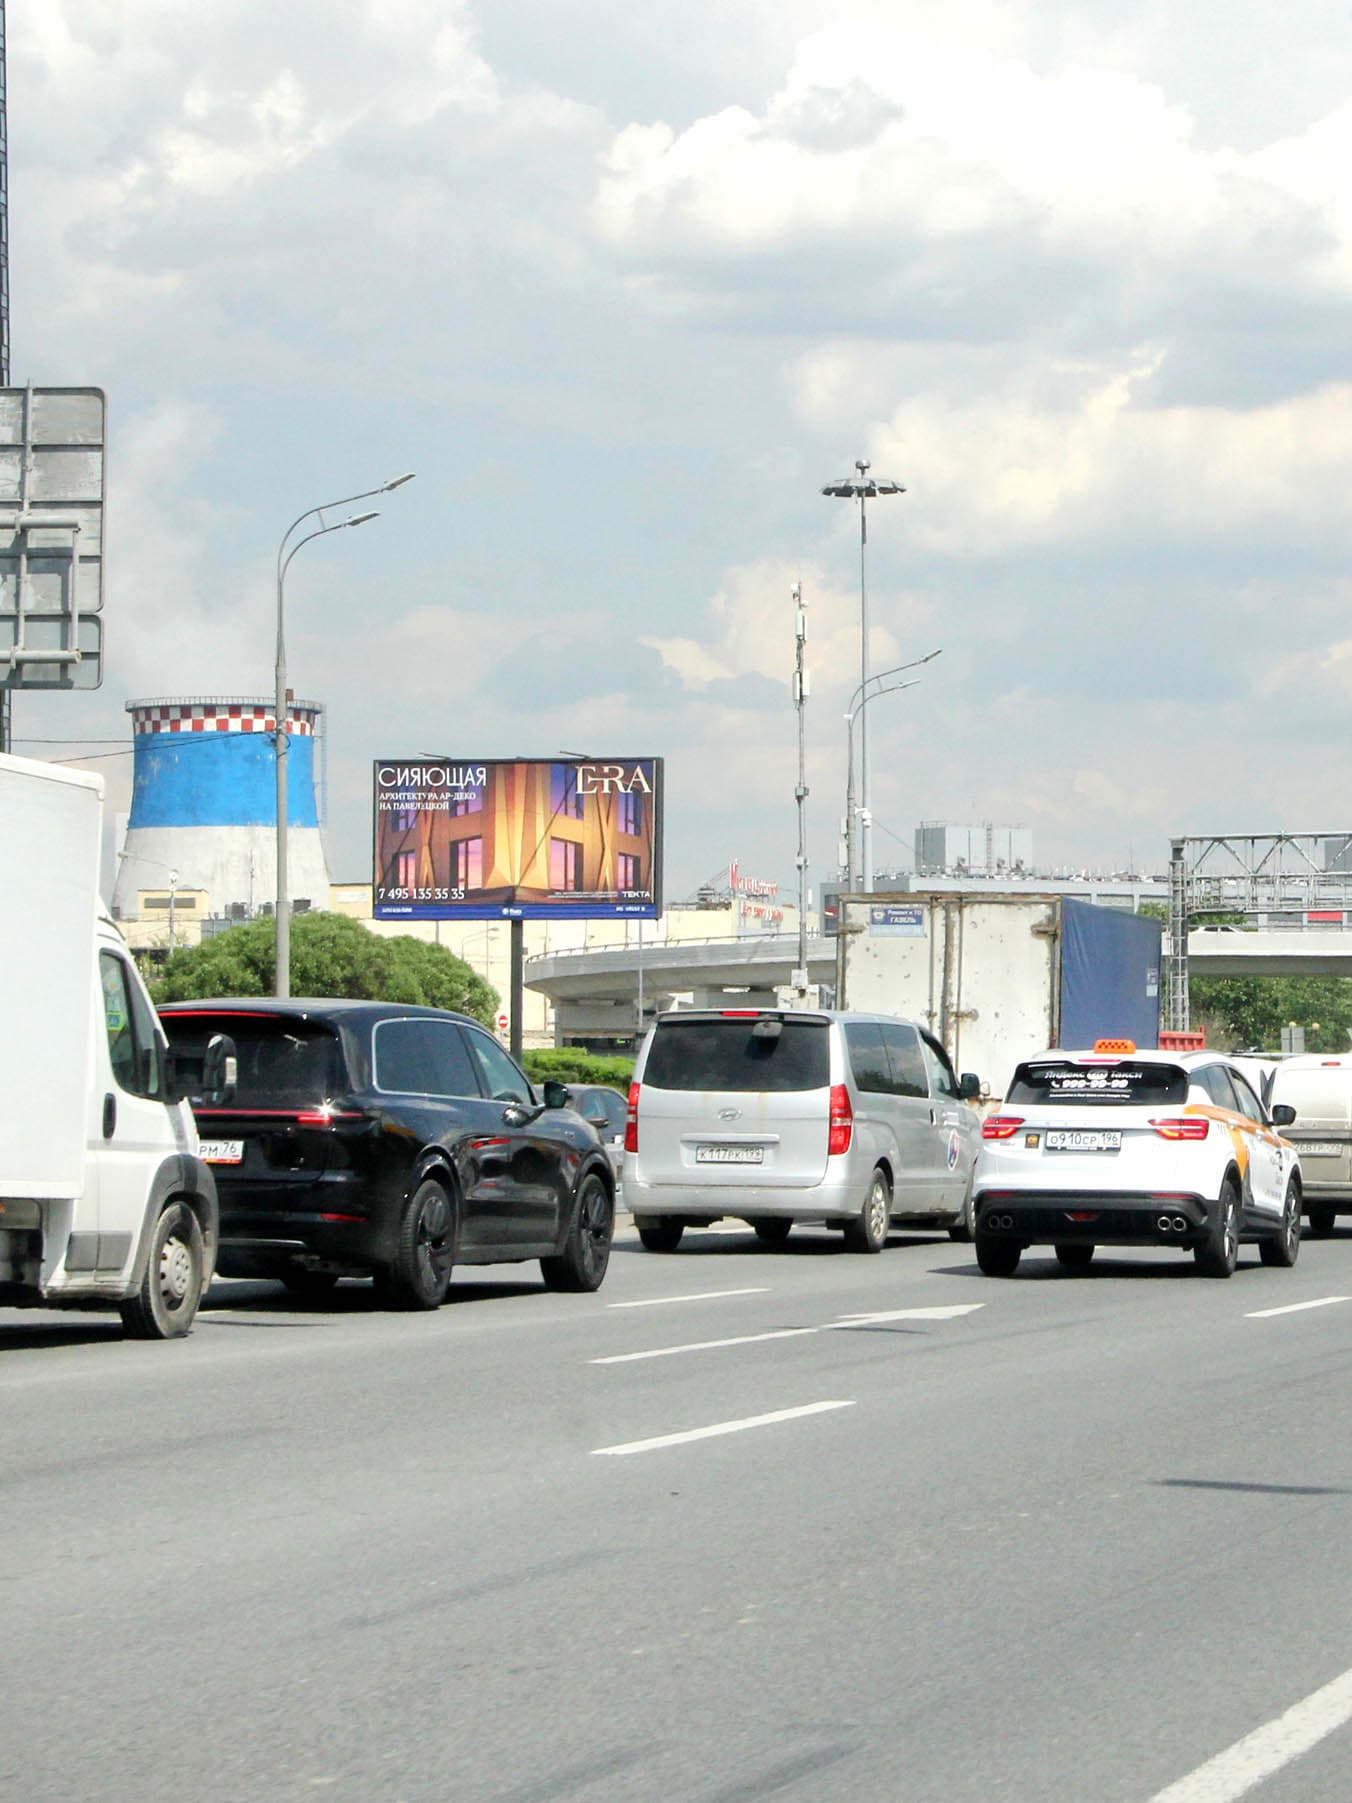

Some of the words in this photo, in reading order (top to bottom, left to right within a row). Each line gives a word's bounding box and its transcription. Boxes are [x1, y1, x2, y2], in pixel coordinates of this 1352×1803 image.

[378, 766, 487, 789] СИЯЮЩАЯ
[575, 765, 652, 794] ERA
[379, 792, 438, 801] АРХИТЕКТУРА
[439, 792, 477, 801] АР-ДЕКО
[379, 801, 392, 810] НА
[393, 801, 450, 811] ПАВЕЛЕЦКОЙ
[378, 888, 385, 899] 7
[387, 888, 409, 899] 495
[412, 888, 432, 899] 135
[434, 888, 449, 899] 35
[451, 888, 465, 899] 35
[223, 1141, 238, 1154] 76
